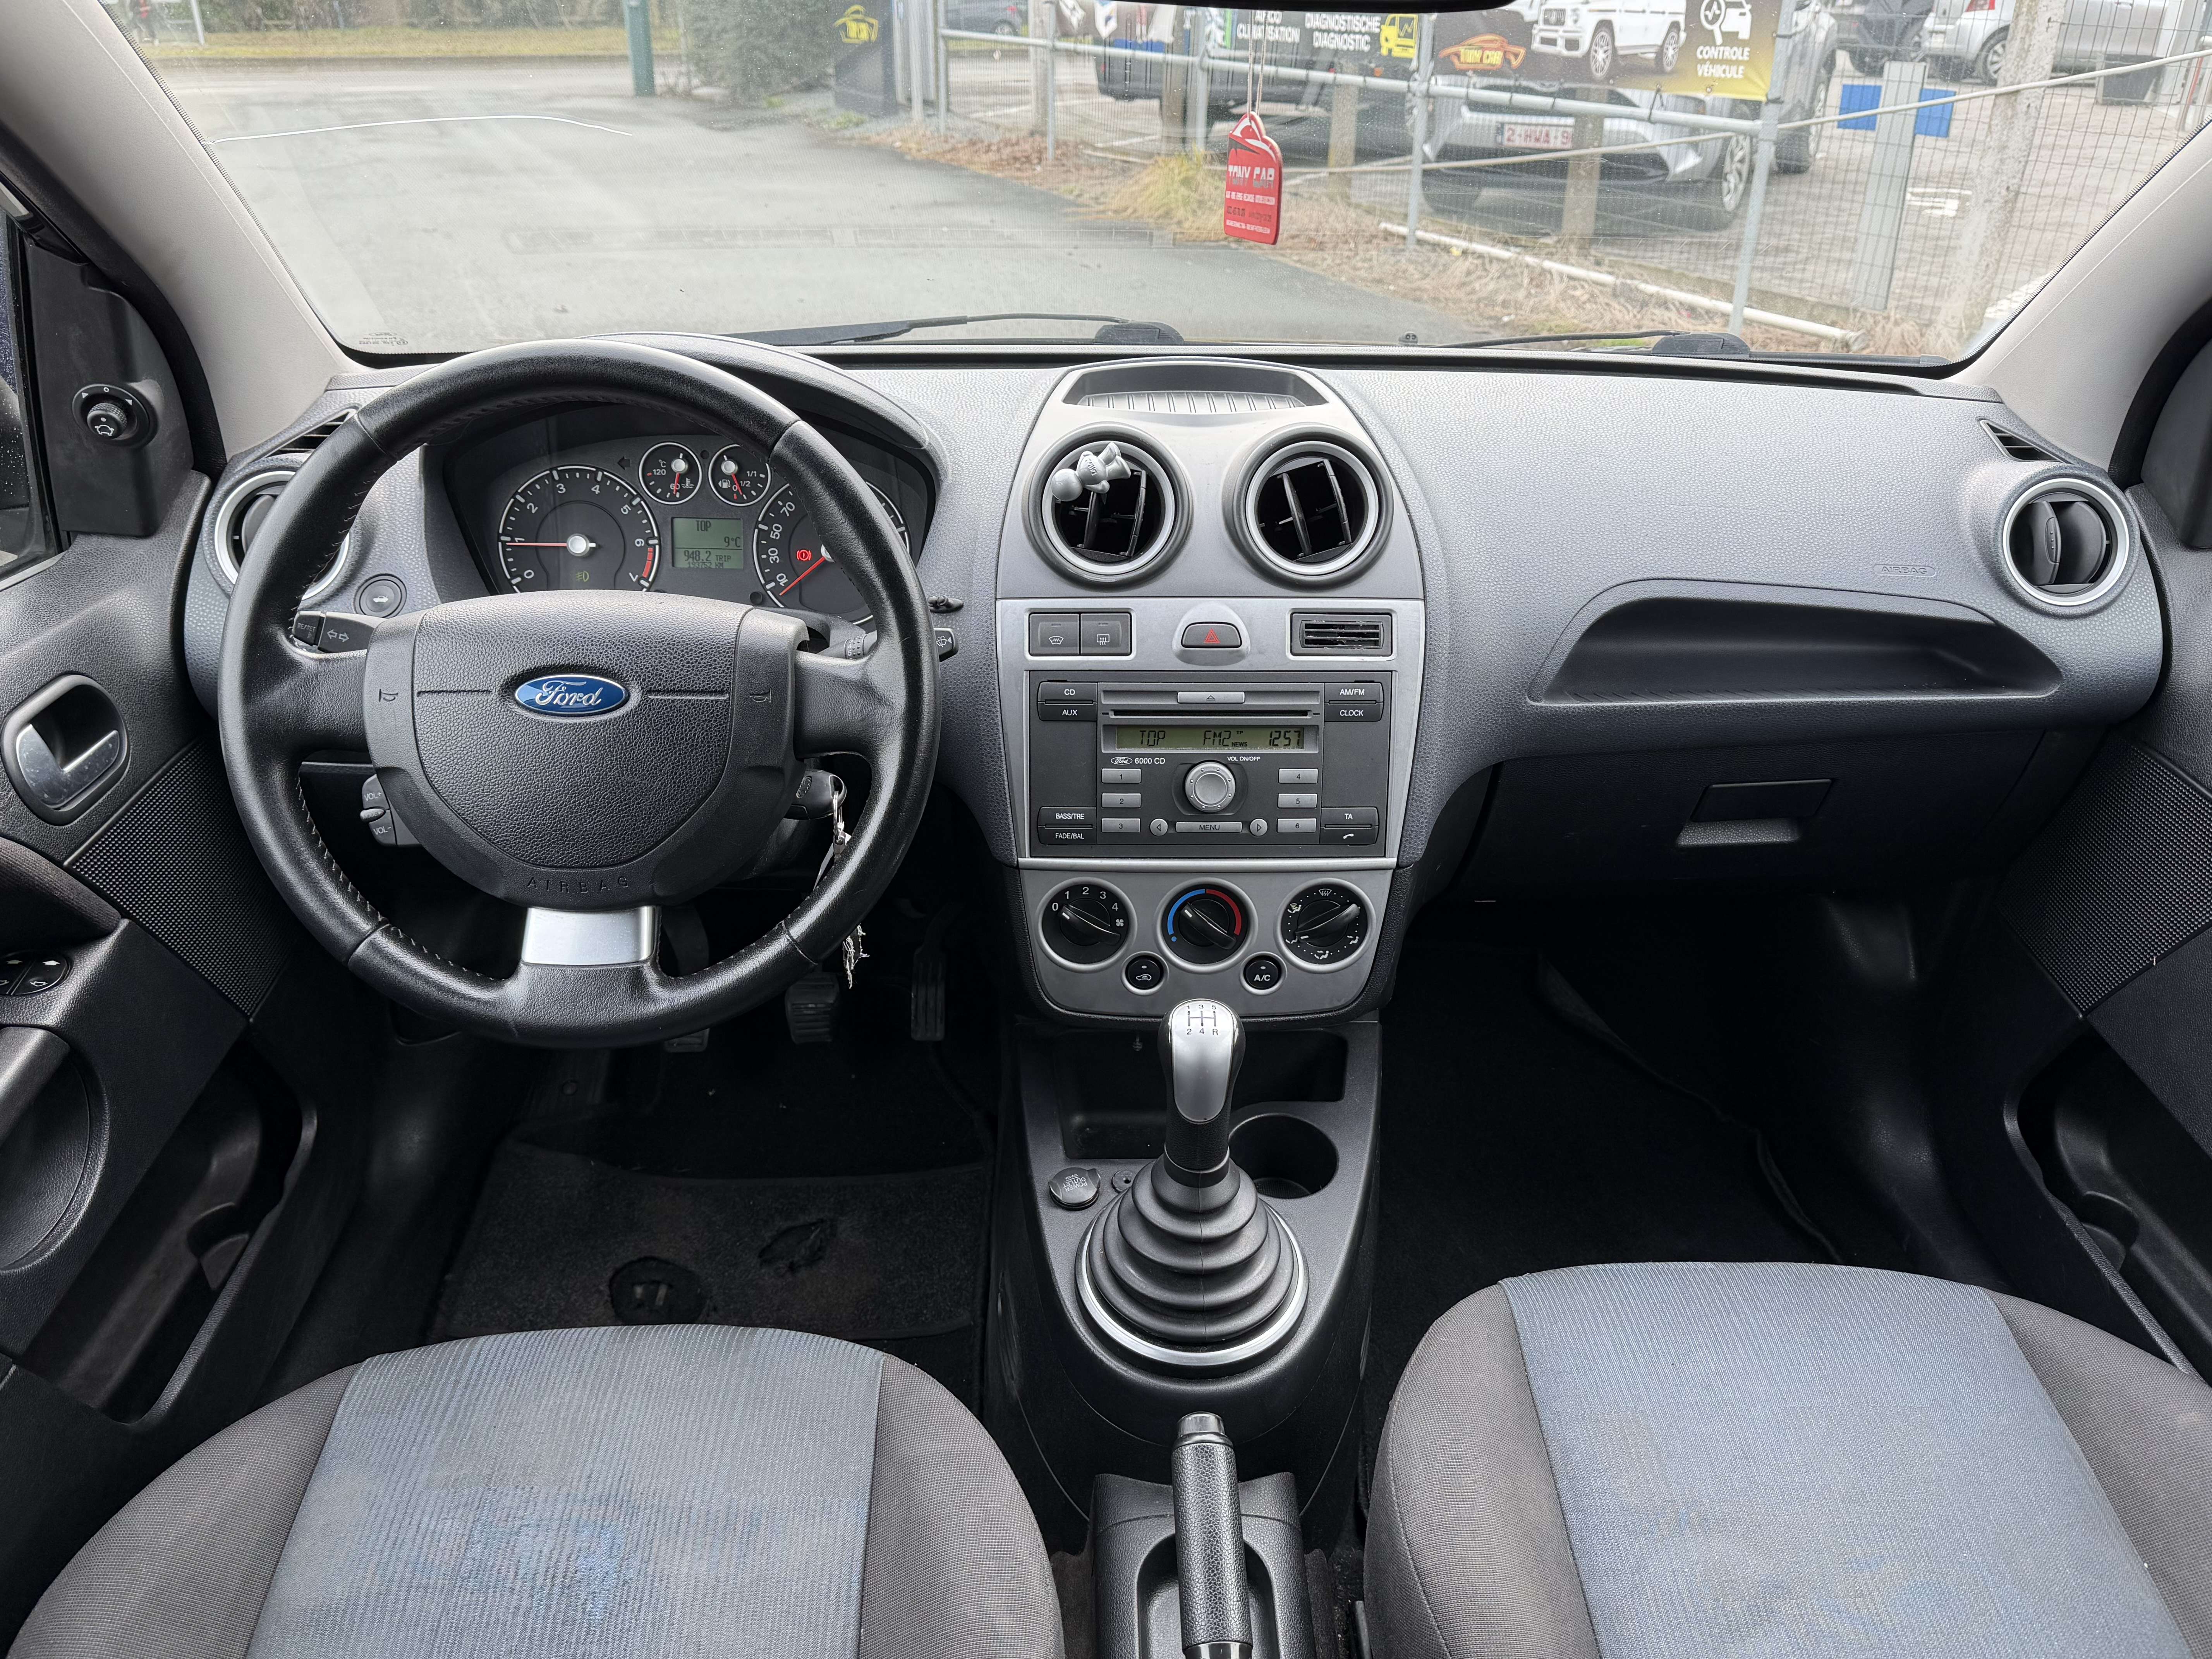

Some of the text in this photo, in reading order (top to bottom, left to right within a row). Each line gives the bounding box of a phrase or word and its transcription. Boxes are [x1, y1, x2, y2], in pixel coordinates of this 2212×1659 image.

[1305, 12, 1381, 33] DIAGNOSTISCHE
[1313, 31, 1371, 52] DIAGNOSTIC
[1696, 45, 1750, 61] CONTROLE
[1697, 60, 1745, 79] VÉHICULE
[556, 483, 566, 494] 3
[591, 484, 600, 495] 4
[527, 503, 538, 514] 2
[620, 504, 632, 515] 5
[780, 502, 795, 517] 70
[696, 520, 711, 532] TOP
[770, 524, 782, 540] 50
[635, 538, 645, 547] 6
[724, 536, 741, 548] 9°C
[684, 550, 711, 562] 948.2
[768, 548, 780, 564] 30
[524, 570, 534, 579] 0
[629, 572, 639, 582] 7
[776, 573, 788, 587] 10
[535, 680, 604, 706] Ford
[1140, 730, 1166, 747] TOP
[1203, 730, 1231, 747] FM2
[364, 792, 382, 801] VOL+
[373, 826, 392, 835] VOL-
[527, 876, 629, 893] AIRBAG
[1065, 891, 1069, 899] 1
[1082, 886, 1089, 895] 2
[1052, 902, 1059, 911] 0
[1112, 903, 1118, 911] 4
[1063, 1177, 1086, 1188] OUTLET
[1064, 1181, 1087, 1192] POWER
